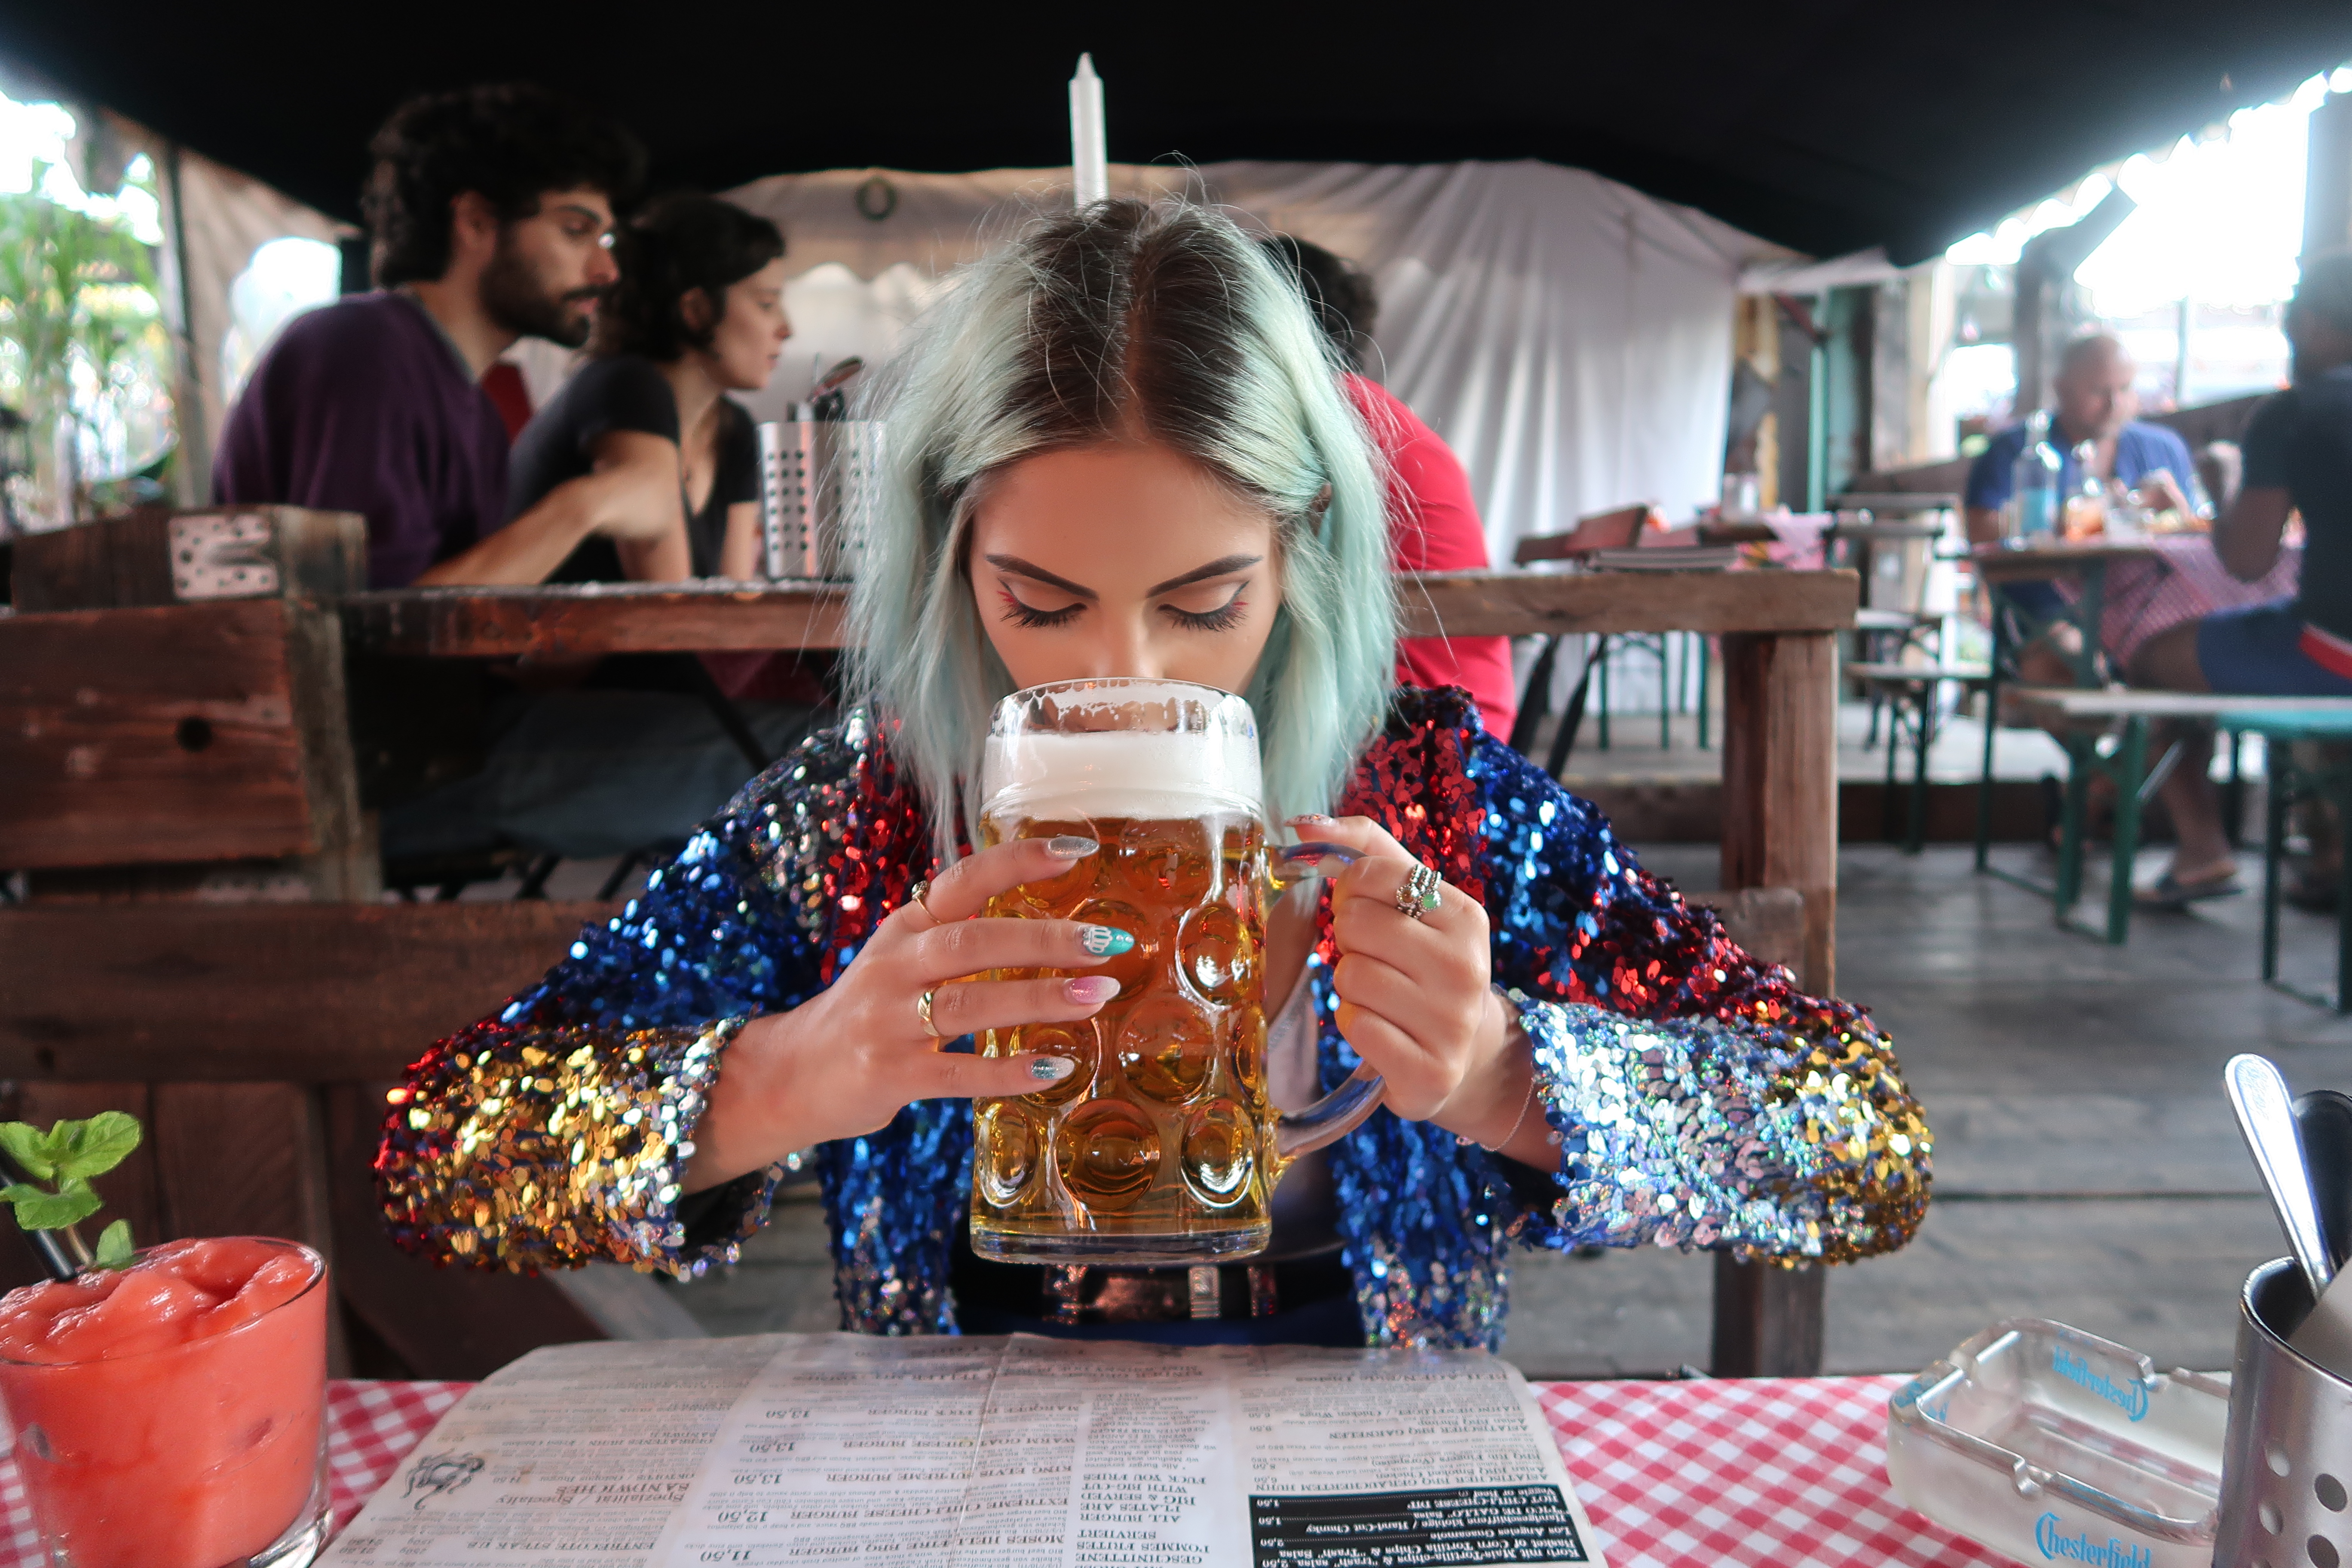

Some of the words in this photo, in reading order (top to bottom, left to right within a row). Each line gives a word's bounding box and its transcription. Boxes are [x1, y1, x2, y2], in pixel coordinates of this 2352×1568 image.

[1329, 1430, 1404, 1439] GARNELEN
[843, 1440, 905, 1449] BURGER
[980, 1467, 1025, 1478] ELVIS
[1032, 1466, 1072, 1474] KING
[733, 1473, 782, 1485] 13,50
[826, 1473, 892, 1482] BURGER
[1168, 1475, 1206, 1485] FUCK
[1455, 1474, 1548, 1483] ASIATISCHER
[1082, 1483, 1141, 1491] BIG-CUT
[1147, 1485, 1187, 1493] WITH
[1081, 1493, 1142, 1501] SERVED
[1473, 1490, 1499, 1498] Beef
[986, 1498, 1068, 1510] EXTREME
[1164, 1495, 1196, 1506] BIG
[1256, 1498, 1280, 1508] 1,50
[1407, 1500, 1431, 1510] DIP
[1433, 1497, 1527, 1508] CHILI-CHEESE
[1080, 1503, 1114, 1511] ARE
[1119, 1504, 1180, 1513] PLATES
[717, 1510, 769, 1523] 12,50
[790, 1510, 858, 1519] BURGER
[1080, 1513, 1142, 1522] BURGER
[1448, 1507, 1499, 1518] GALLO"
[1148, 1514, 1181, 1522] ALL
[1258, 1516, 1282, 1527] 1,50
[1305, 1524, 1351, 1534] Chunky
[1353, 1521, 1409, 1532] Hand-Cut
[1412, 1521, 1418, 1529] /
[1421, 1519, 1465, 1529] klobige
[1077, 1530, 1156, 1540] SERVIERT
[1430, 1529, 1495, 1540] Guacamole
[1498, 1526, 1545, 1537] Angeles
[1548, 1526, 1571, 1535] Los
[1007, 1534, 1064, 1544] MOSES
[1260, 1537, 1285, 1548] 2,50
[1514, 1539, 1527, 1548] of
[1530, 1539, 1575, 1548] Basket
[2035, 1511, 2151, 1568] Chesterfield
[865, 1544, 900, 1552] BBQ
[1076, 1541, 1134, 1551] FRITES
[1141, 1542, 1210, 1554] POMMES
[1385, 1544, 1421, 1554] Chips
[1425, 1541, 1474, 1552] Tortilla
[1477, 1540, 1509, 1549] Corn
[699, 1549, 753, 1562] 11,50
[788, 1546, 860, 1556] BURGER
[1278, 1549, 1313, 1559] Salsa
[1318, 1547, 1366, 1558] "Trash"
[1371, 1547, 1381, 1556] &
[1520, 1550, 1543, 1559] mit
[1075, 1553, 1202, 1564] GESCHNITTENE
[1262, 1559, 1289, 1568] 2,50
[1383, 1556, 1393, 1565] &
